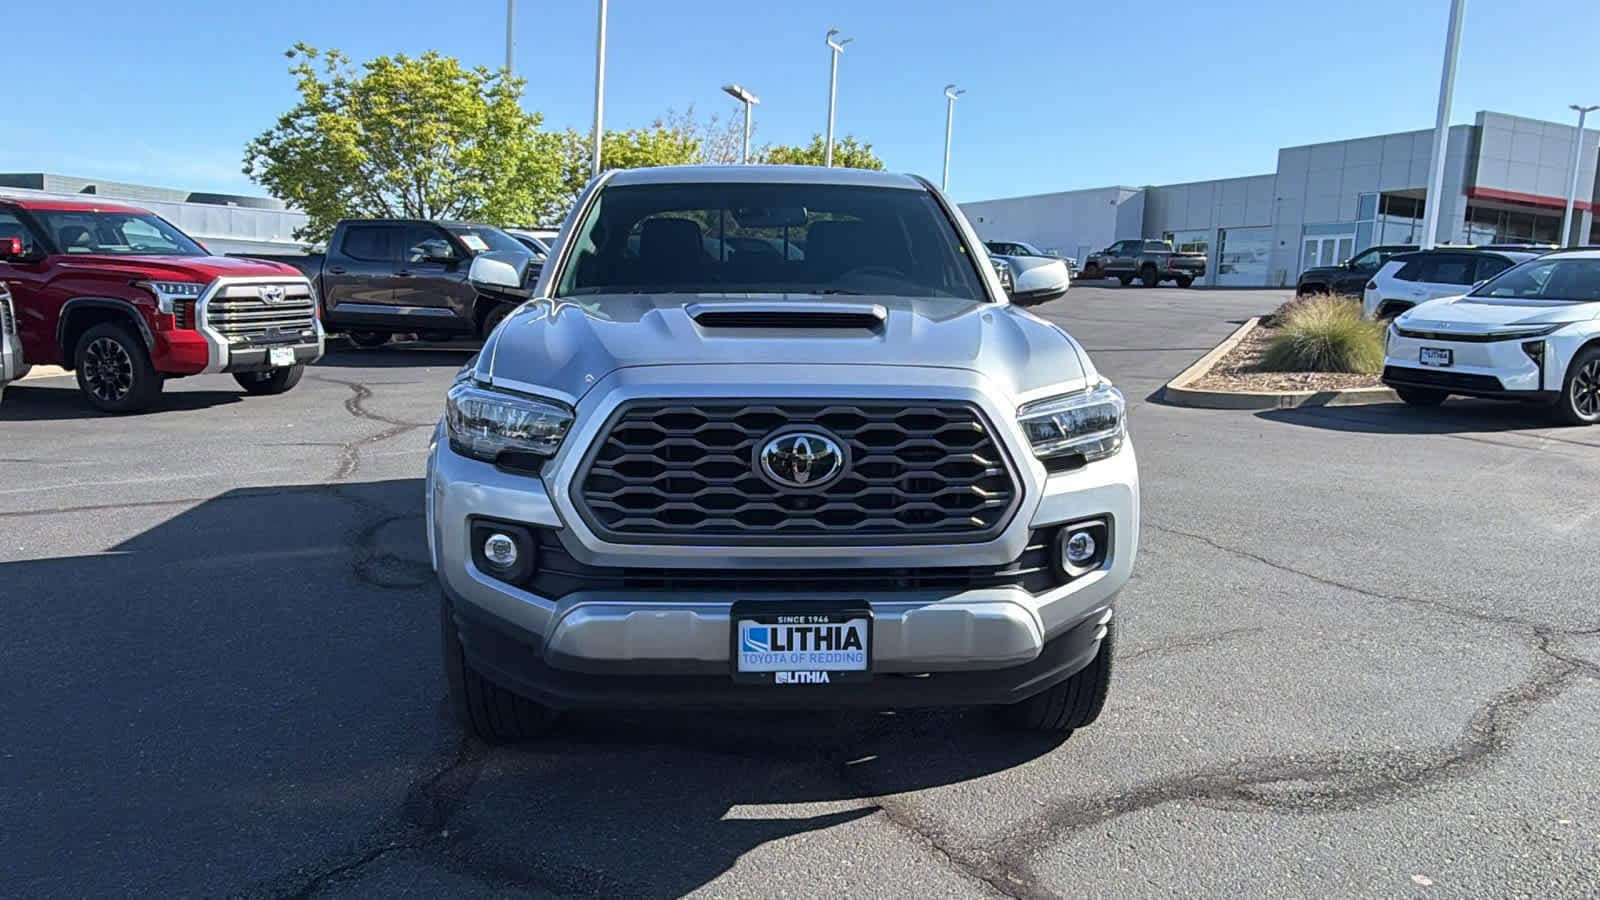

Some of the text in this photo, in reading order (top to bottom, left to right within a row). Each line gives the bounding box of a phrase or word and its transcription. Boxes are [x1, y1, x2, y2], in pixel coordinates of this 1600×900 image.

[777, 616, 805, 624] SINCE
[770, 626, 863, 652] LITHIA
[742, 653, 864, 664] TOYOTA OF REDDING
[787, 671, 830, 684] LITHIA
